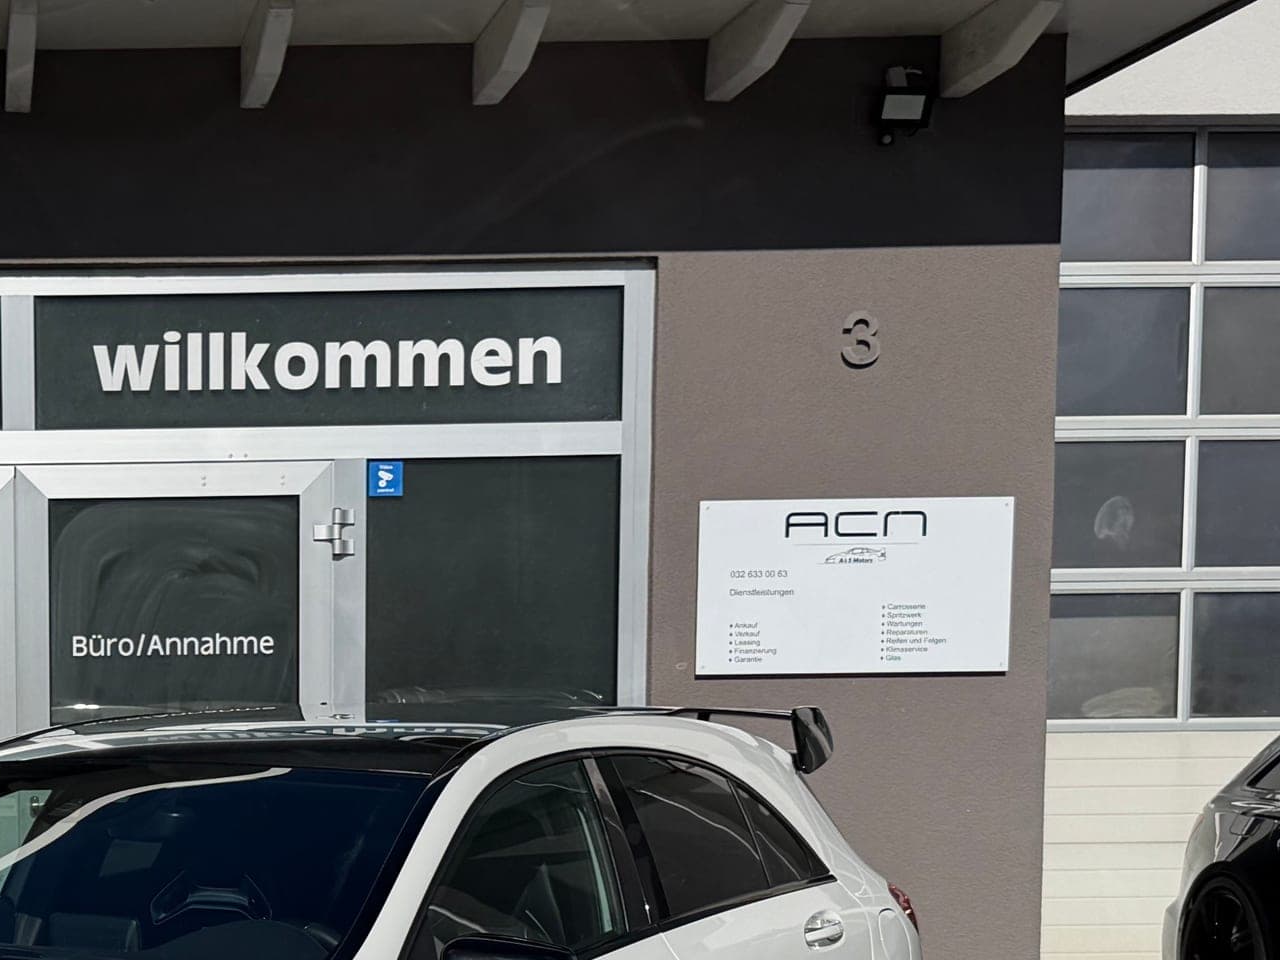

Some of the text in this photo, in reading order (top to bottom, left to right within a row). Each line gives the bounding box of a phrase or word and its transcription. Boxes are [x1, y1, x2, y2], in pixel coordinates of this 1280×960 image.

[841, 311, 880, 369] 3
[93, 331, 562, 392] willkommen
[785, 511, 927, 538] ACN
[730, 570, 746, 578] 032
[747, 570, 763, 578] 633
[764, 570, 775, 578] 00
[729, 588, 794, 597] Dienstleistungen
[72, 633, 275, 657] Büro/Annahme
[886, 637, 908, 645] Reifen
[734, 648, 777, 656] Finanzierung
